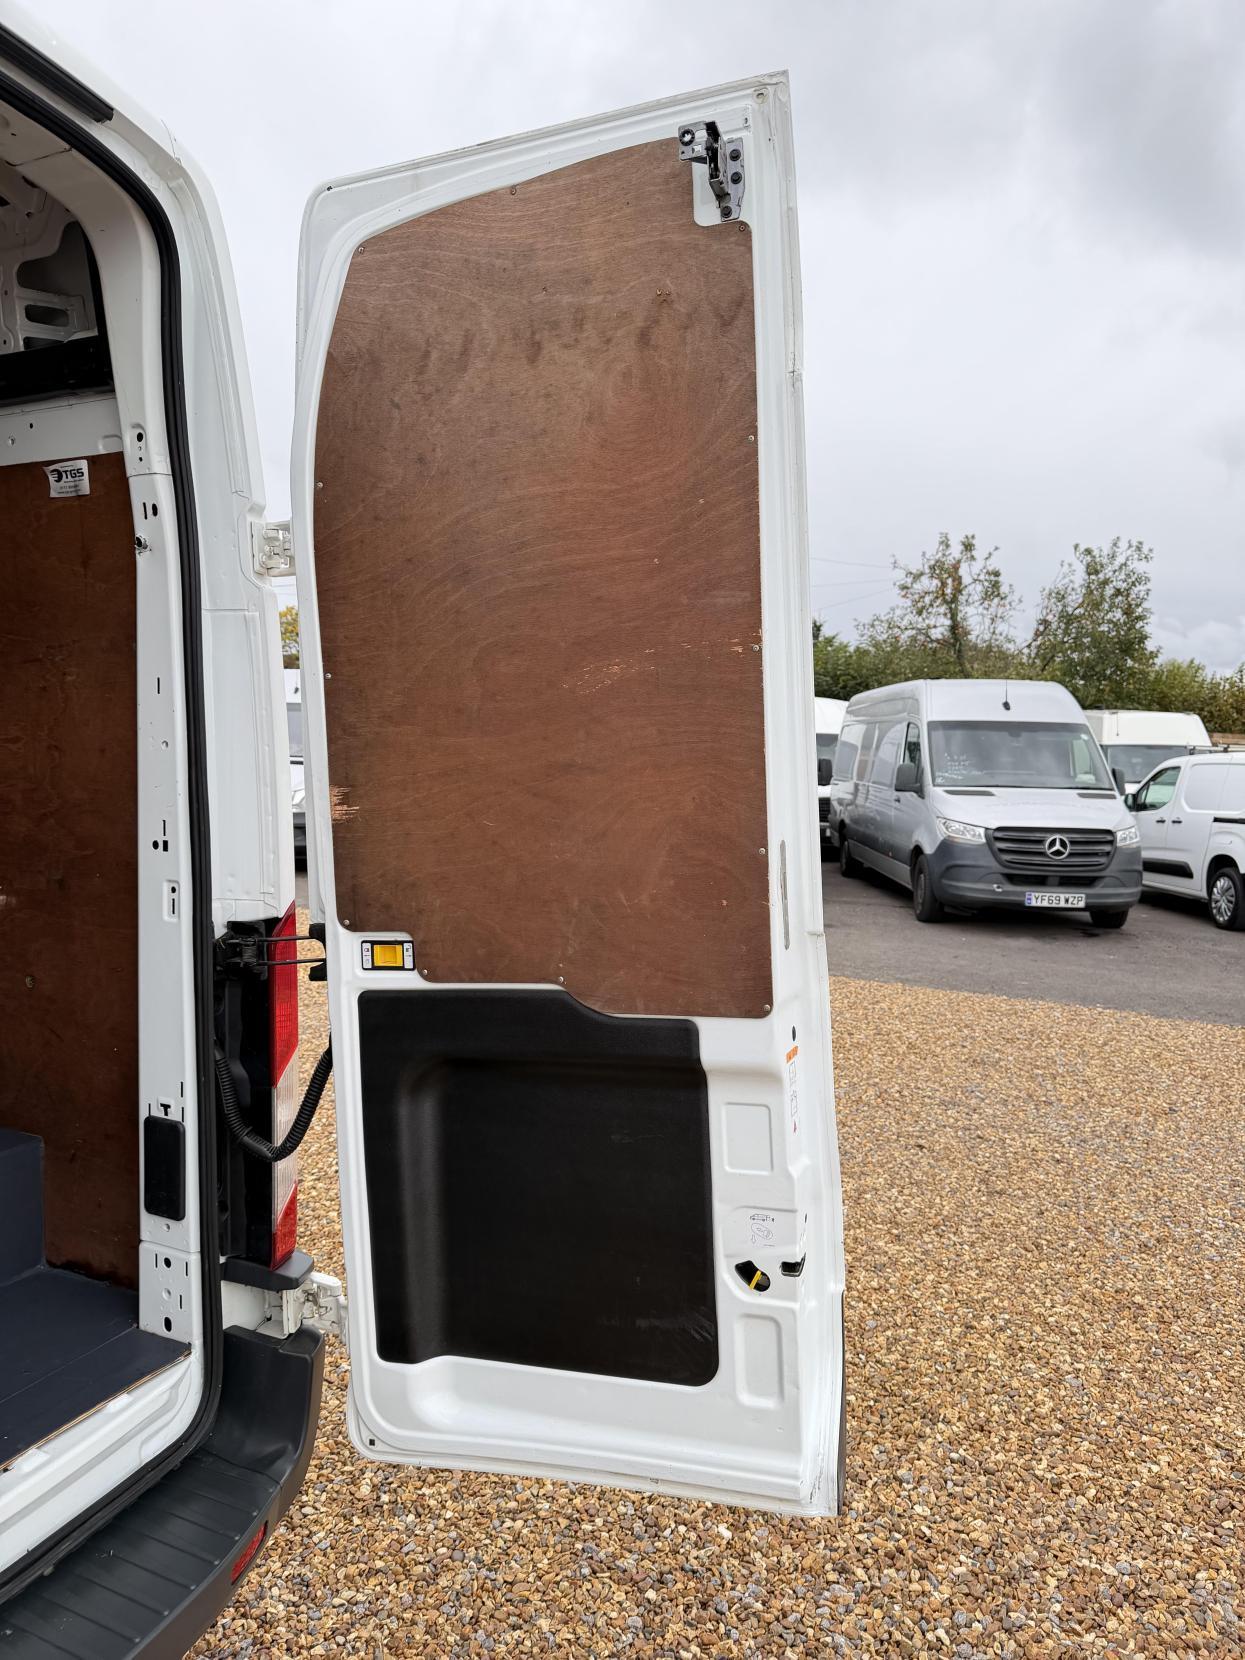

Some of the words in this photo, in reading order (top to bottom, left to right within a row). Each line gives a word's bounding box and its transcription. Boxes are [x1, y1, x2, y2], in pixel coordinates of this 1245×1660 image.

[62, 468, 84, 479] TGS
[1033, 894, 1060, 905] YF69
[1063, 895, 1084, 906] WZP
